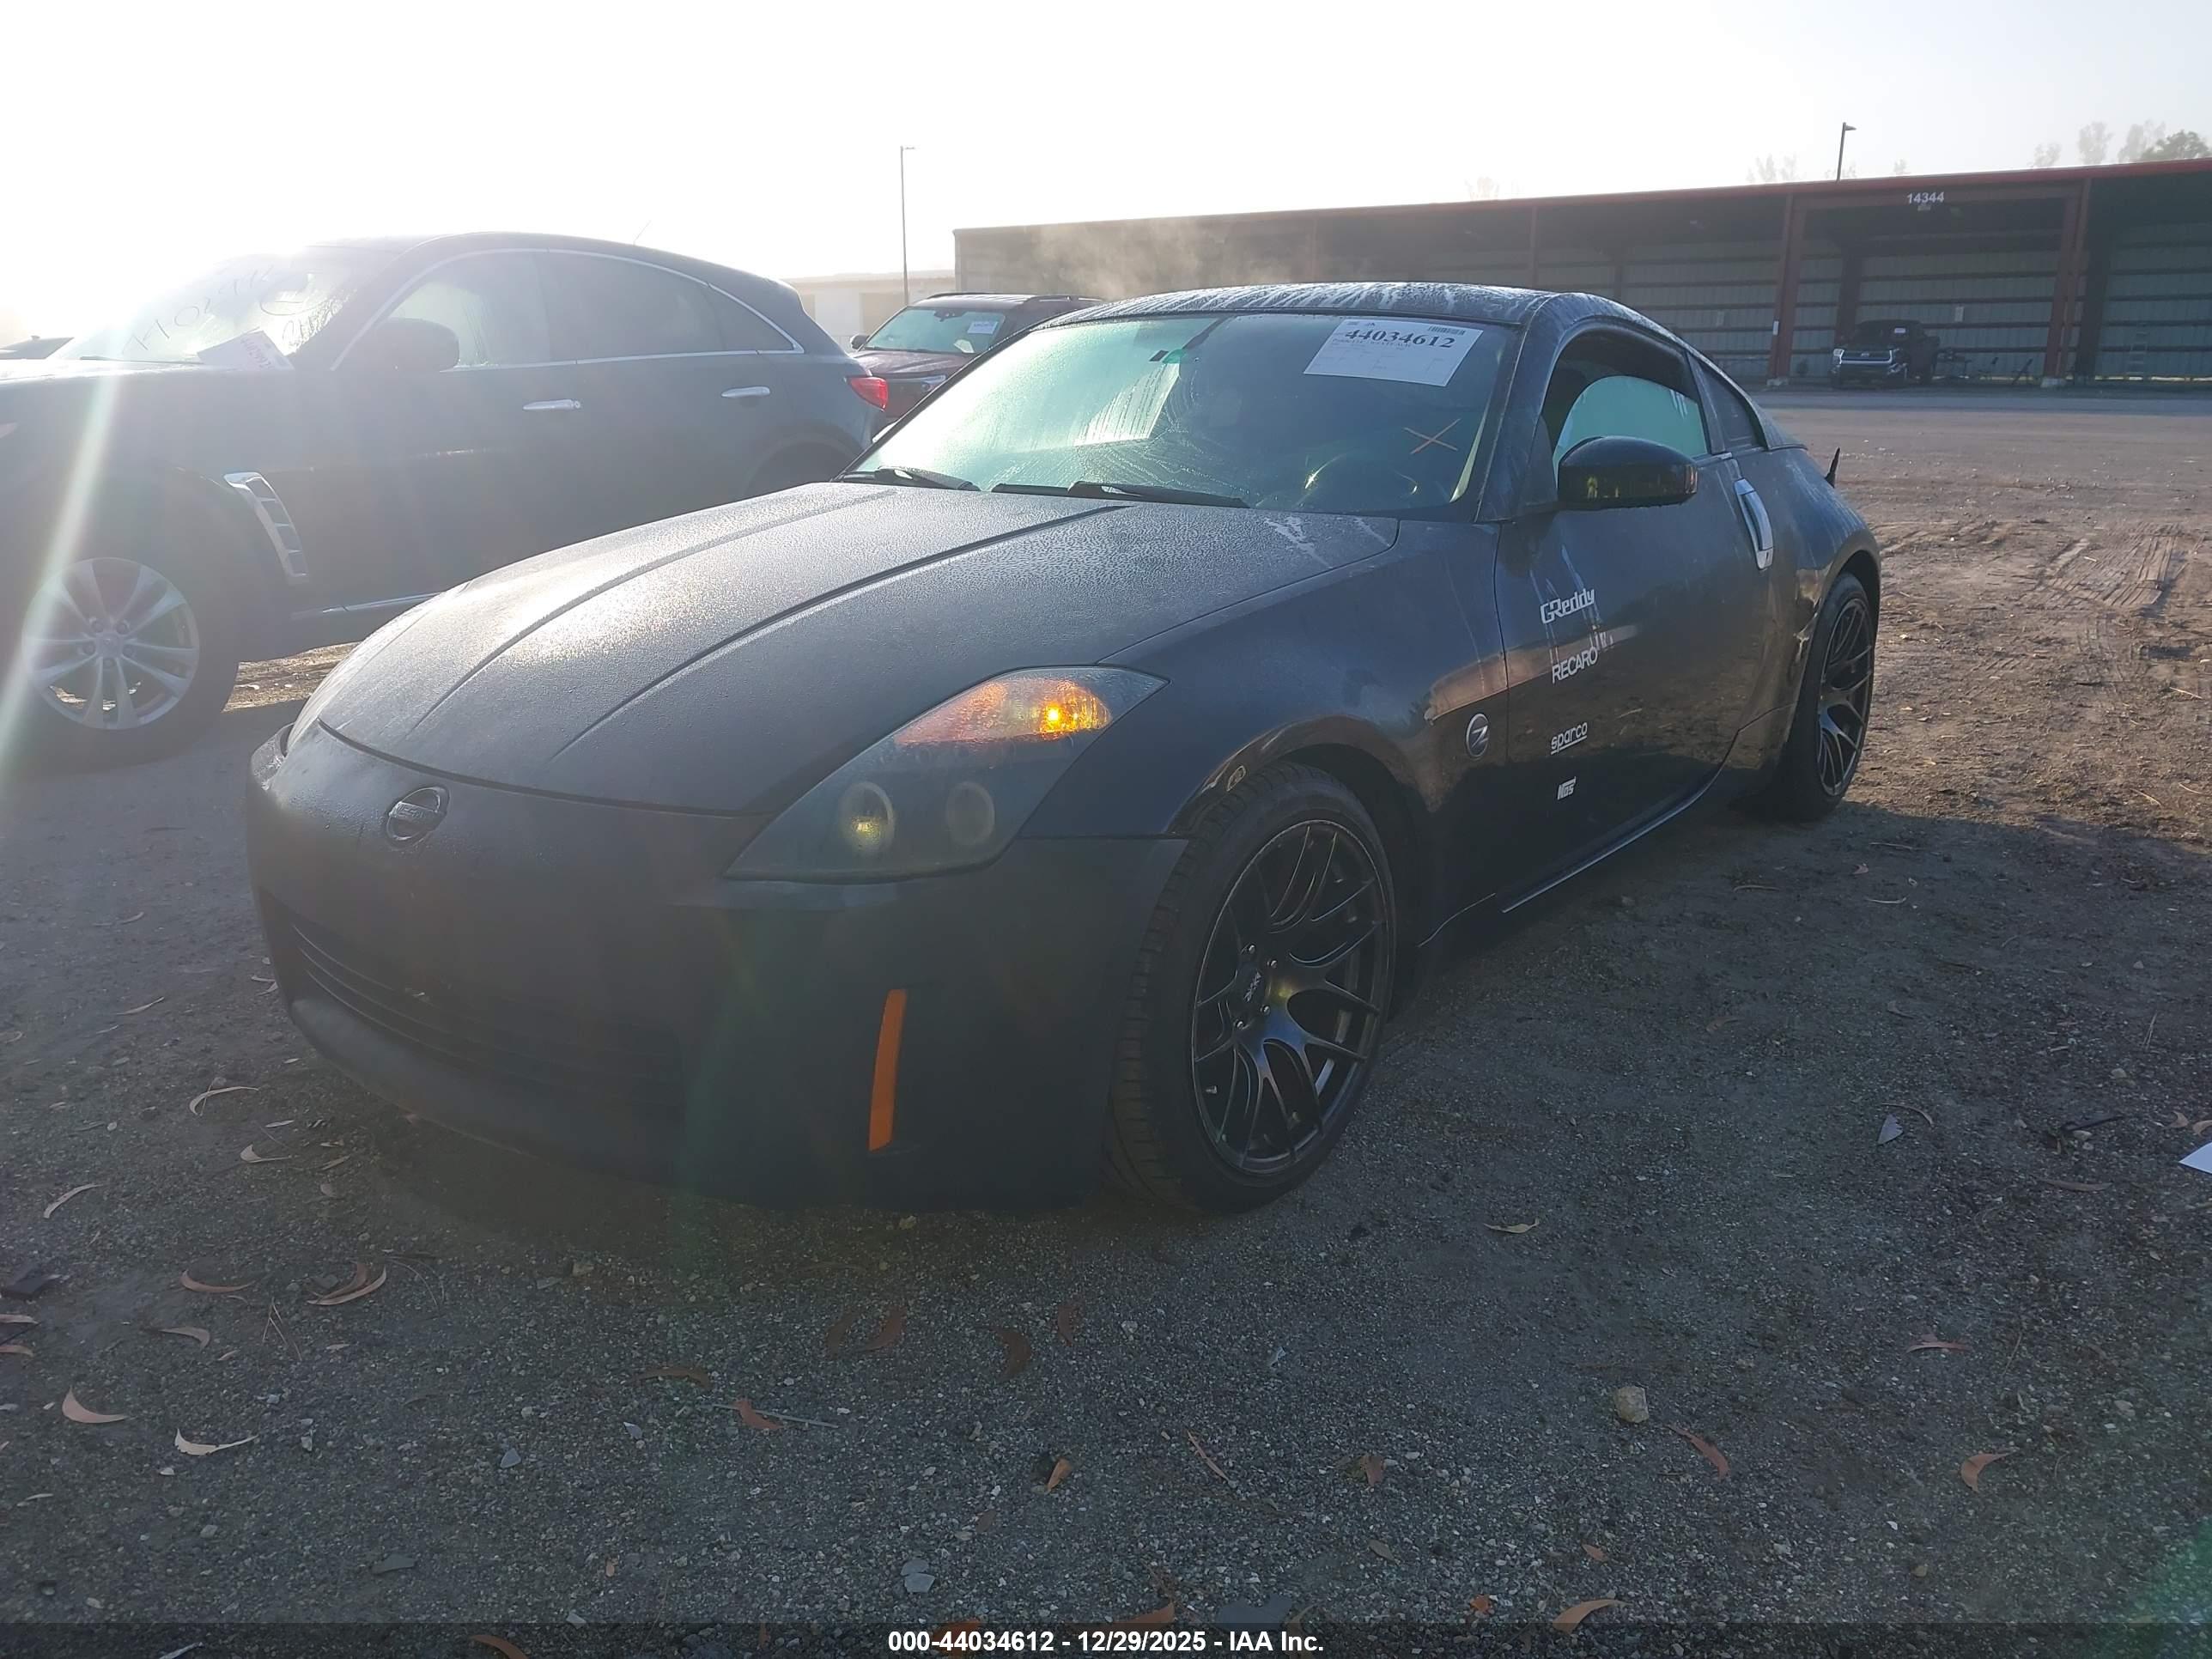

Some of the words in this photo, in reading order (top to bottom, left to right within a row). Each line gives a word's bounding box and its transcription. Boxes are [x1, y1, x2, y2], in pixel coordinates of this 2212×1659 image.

[1907, 191, 1945, 204] 14344
[1345, 329, 1456, 349] 44034612
[1540, 588, 1595, 625] GReddy
[1552, 646, 1599, 684] RECARO
[1550, 722, 1588, 753] sparco
